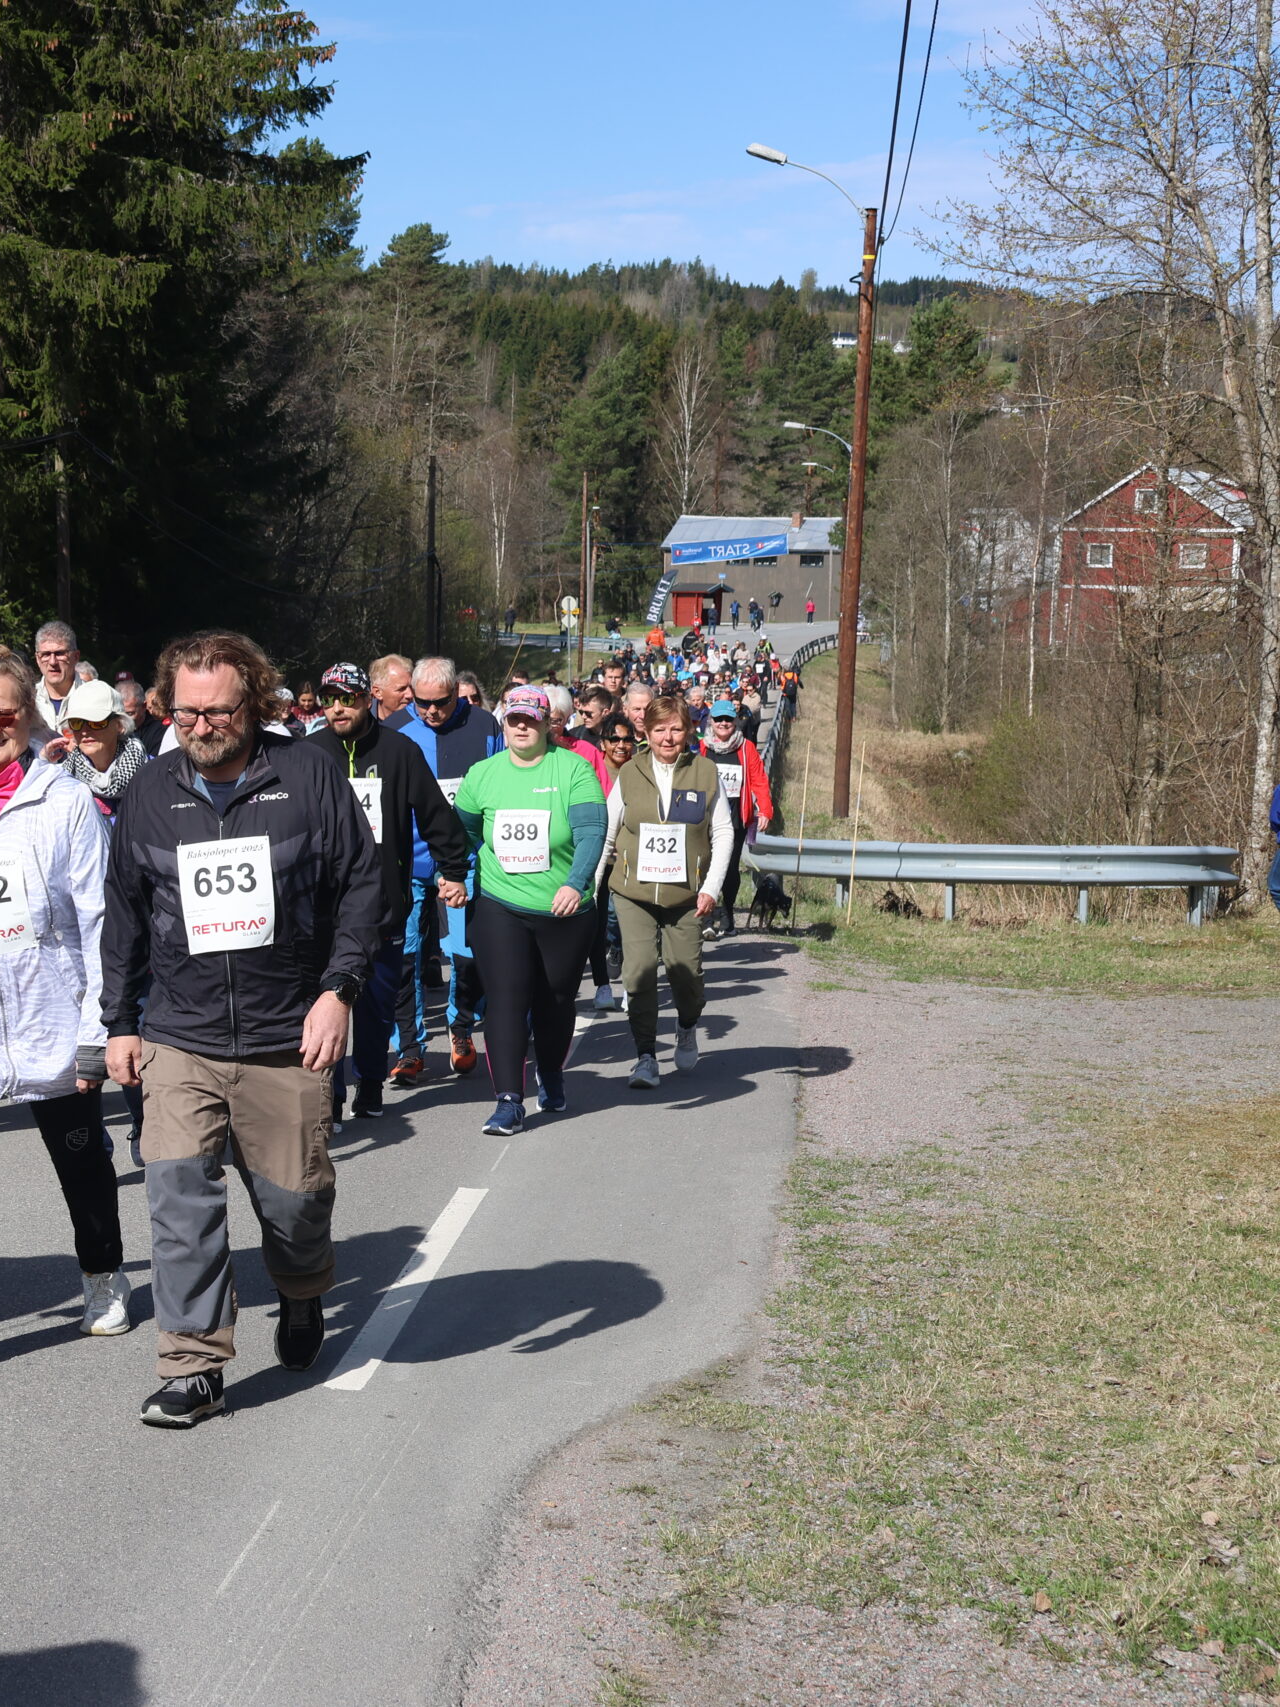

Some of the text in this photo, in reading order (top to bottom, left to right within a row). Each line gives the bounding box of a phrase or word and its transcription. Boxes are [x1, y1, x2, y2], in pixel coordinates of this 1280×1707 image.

[646, 577, 671, 622] BRUKET
[259, 792, 289, 801] OneCo
[501, 823, 538, 841] 389
[241, 843, 264, 852] 2025
[645, 837, 677, 853] 432
[194, 862, 257, 897] 653
[192, 920, 260, 936] RETURA
